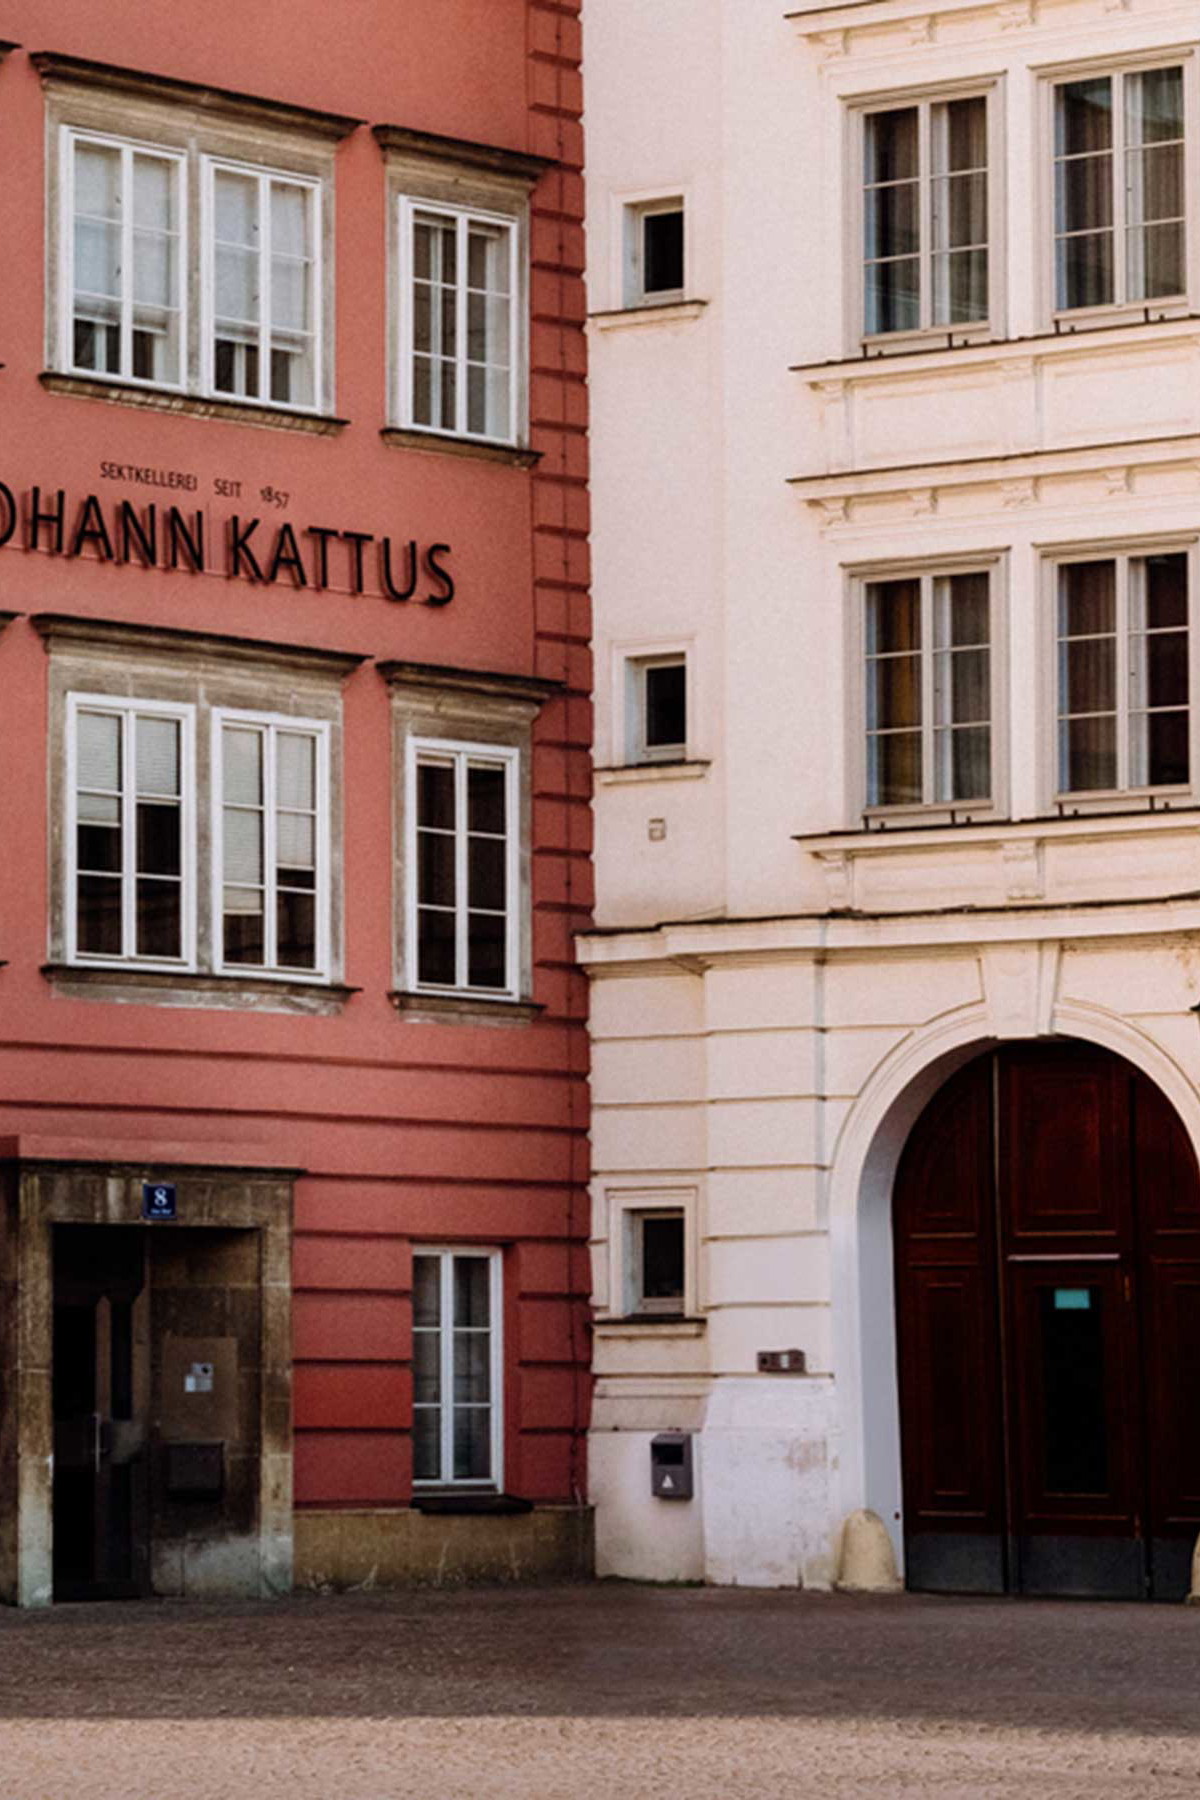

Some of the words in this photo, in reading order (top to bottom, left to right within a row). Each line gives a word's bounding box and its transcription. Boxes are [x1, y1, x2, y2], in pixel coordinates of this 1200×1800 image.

[100, 461, 198, 491] SEKTKELLEREI
[213, 478, 242, 498] SEIT
[260, 486, 290, 509] 1857
[228, 515, 455, 607] KATTUS
[154, 1187, 168, 1206] 8
